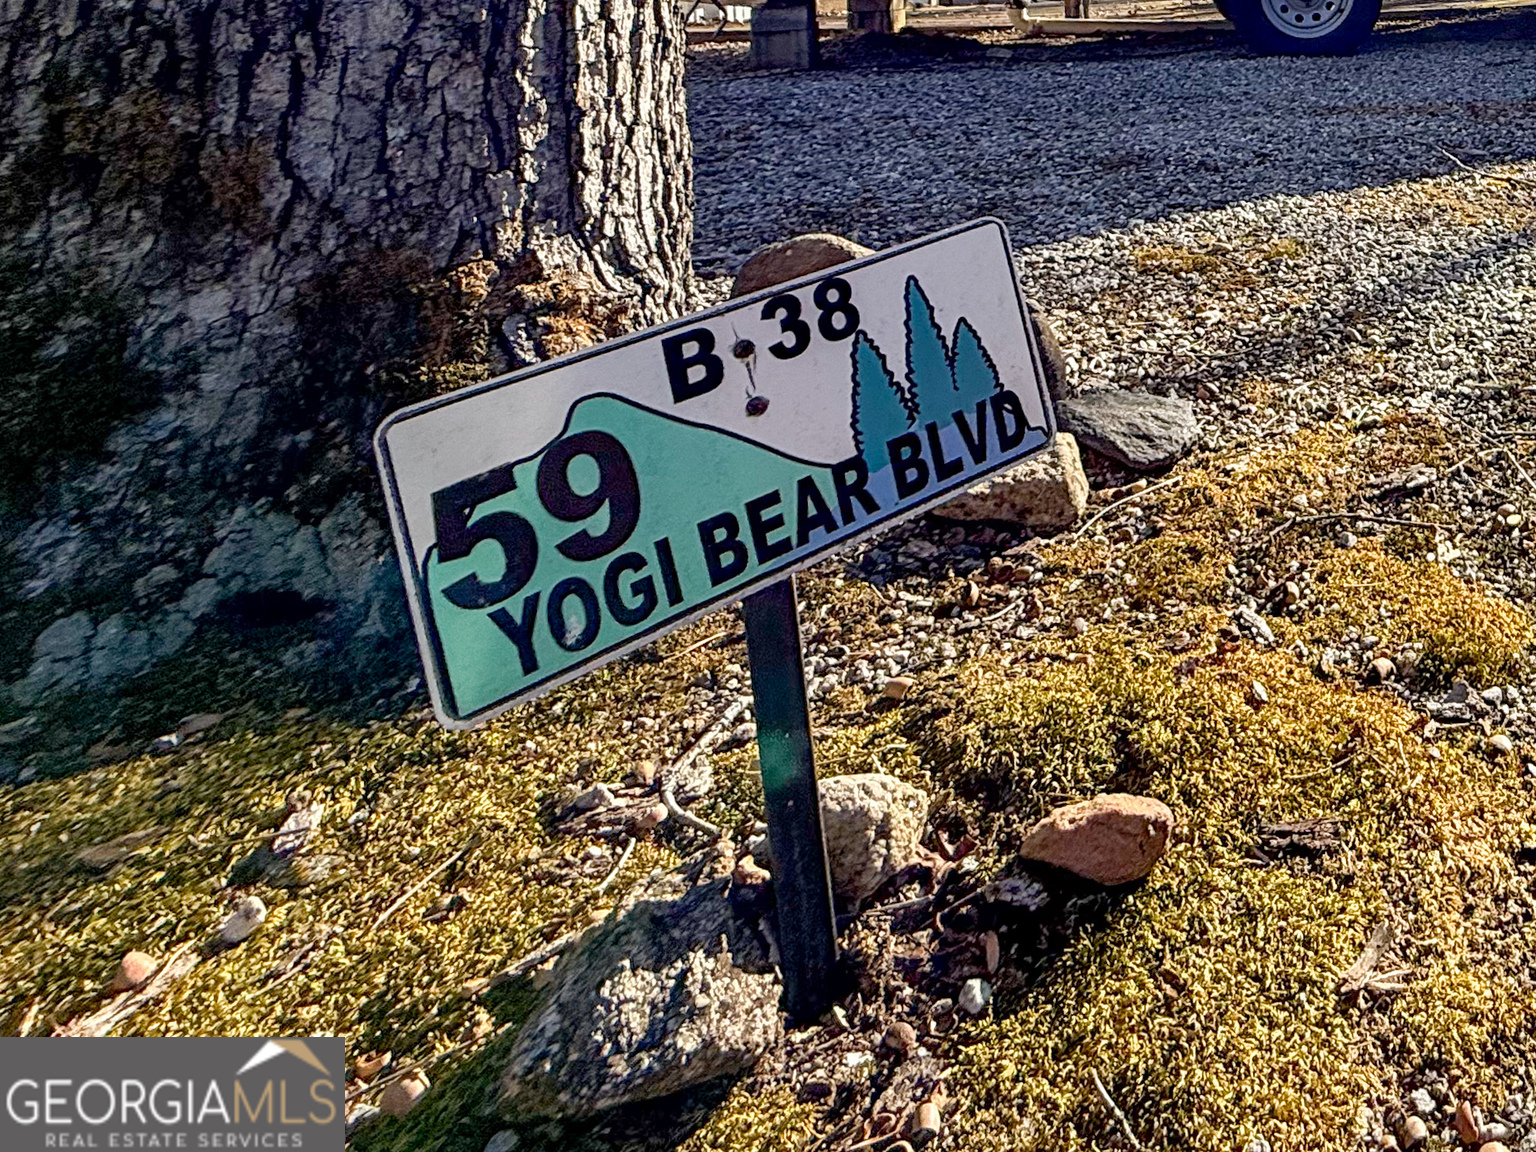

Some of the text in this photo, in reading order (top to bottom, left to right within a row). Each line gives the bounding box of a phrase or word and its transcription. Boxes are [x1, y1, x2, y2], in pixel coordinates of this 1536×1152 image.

[430, 429, 641, 610] 59
[487, 390, 1028, 677] YOGI BEAR BLVD
